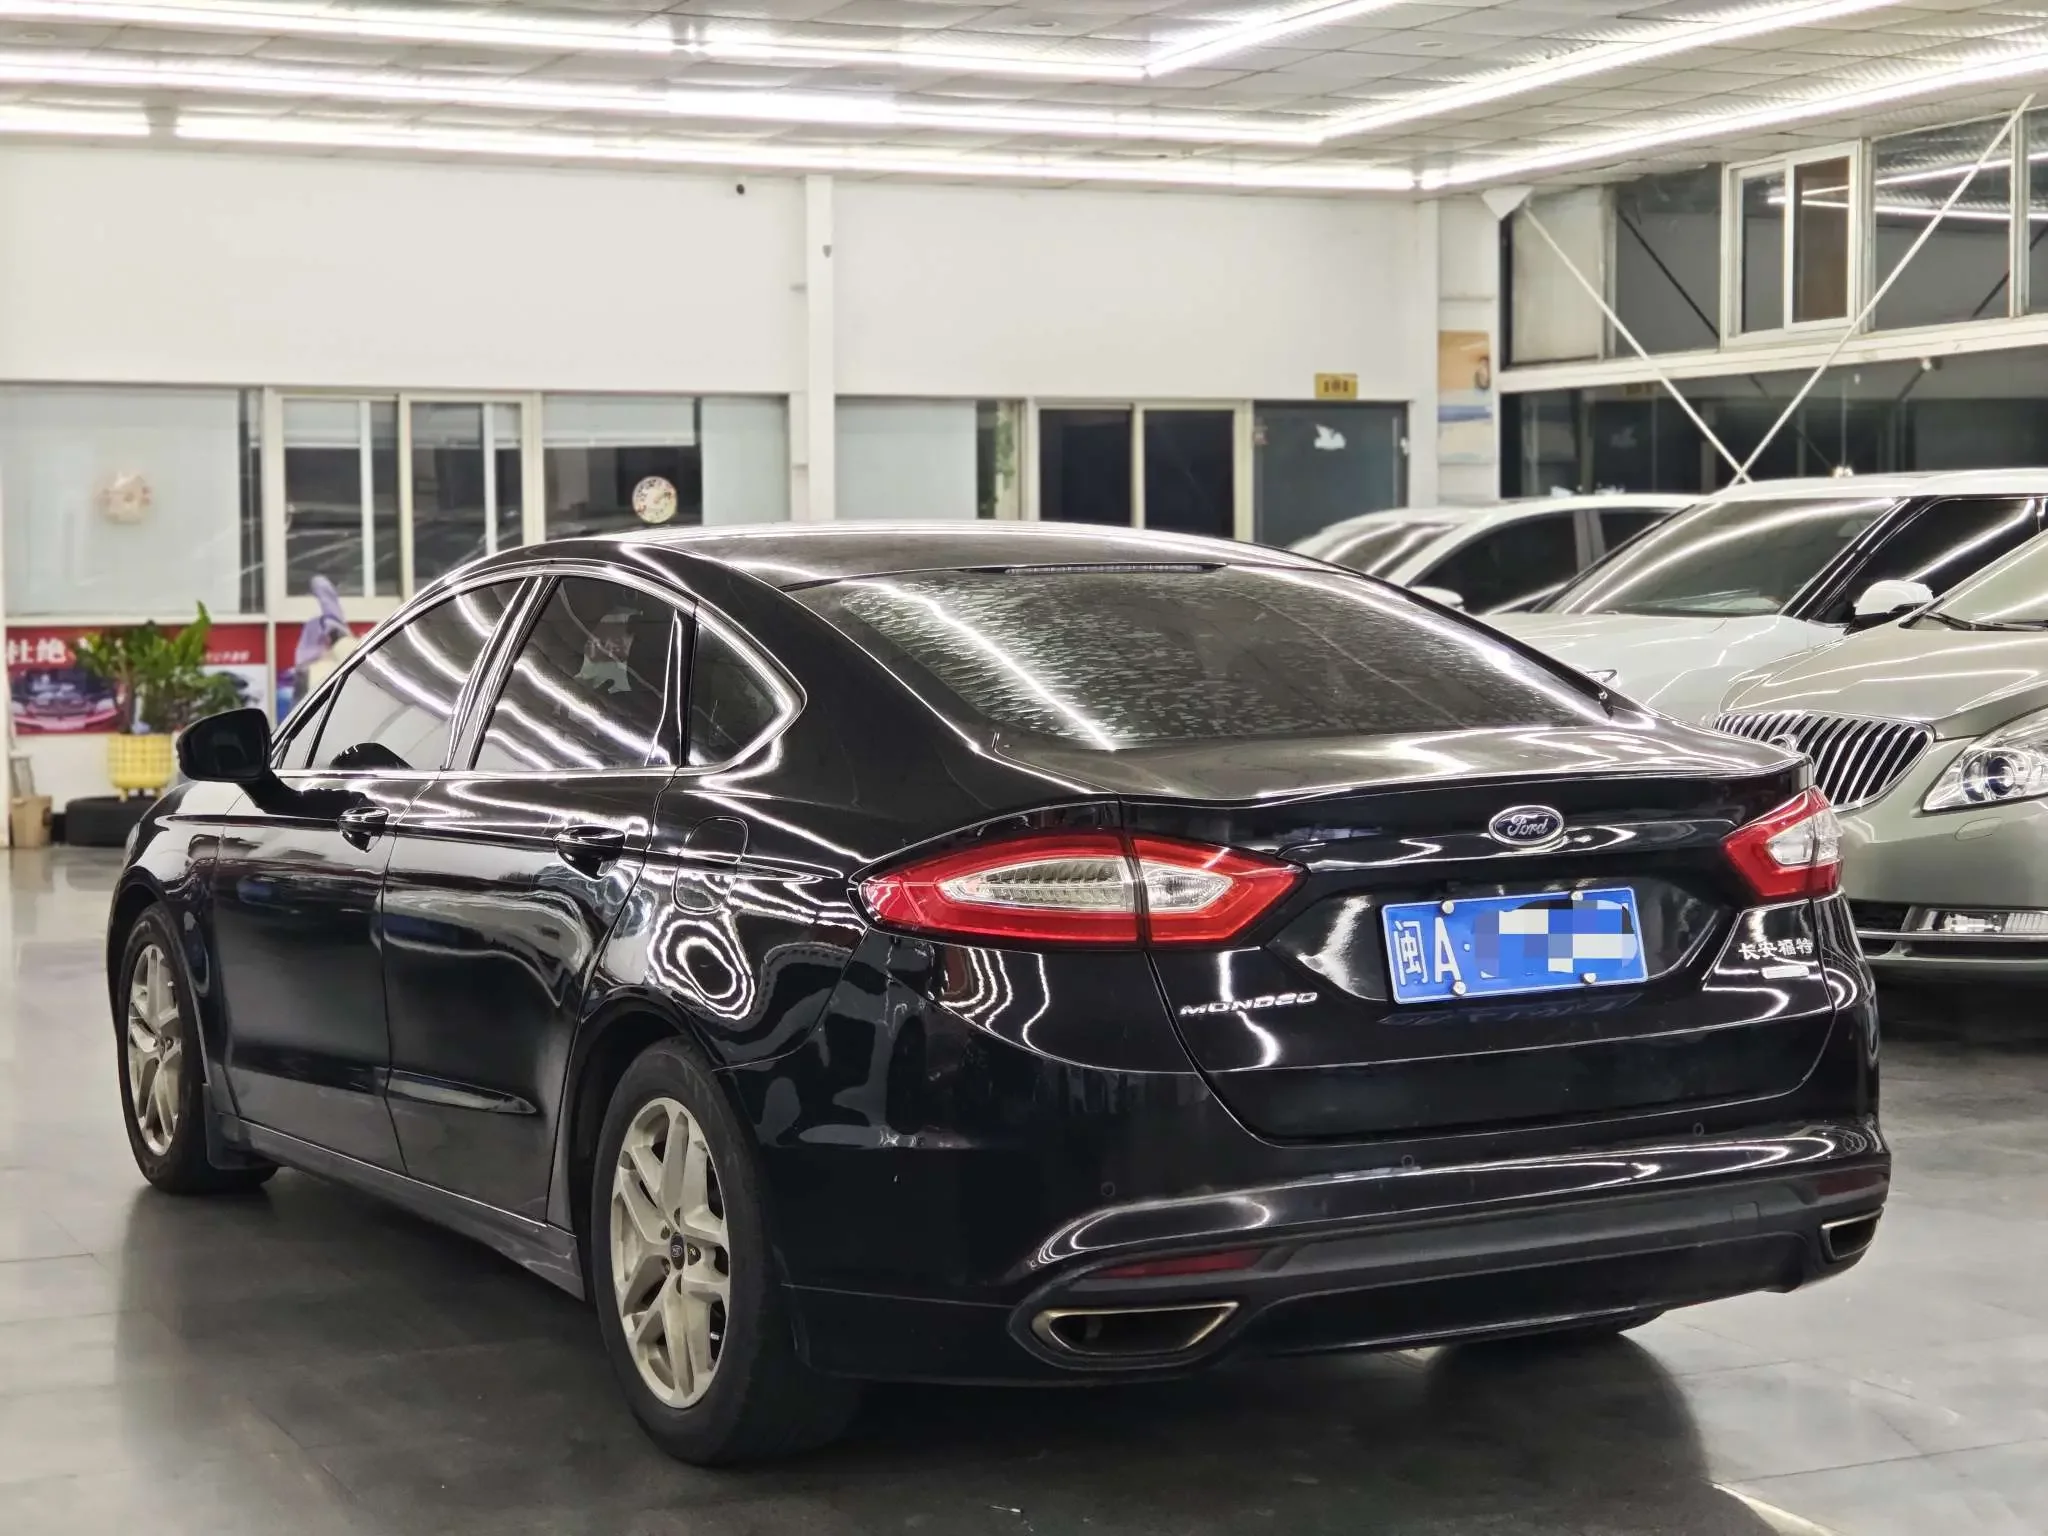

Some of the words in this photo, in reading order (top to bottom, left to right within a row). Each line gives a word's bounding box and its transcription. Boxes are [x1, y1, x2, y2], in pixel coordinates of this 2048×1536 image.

[1507, 814, 1549, 836] Ford
[1739, 938, 1813, 960] 长安福特
[1179, 992, 1318, 1015] MONDEO
